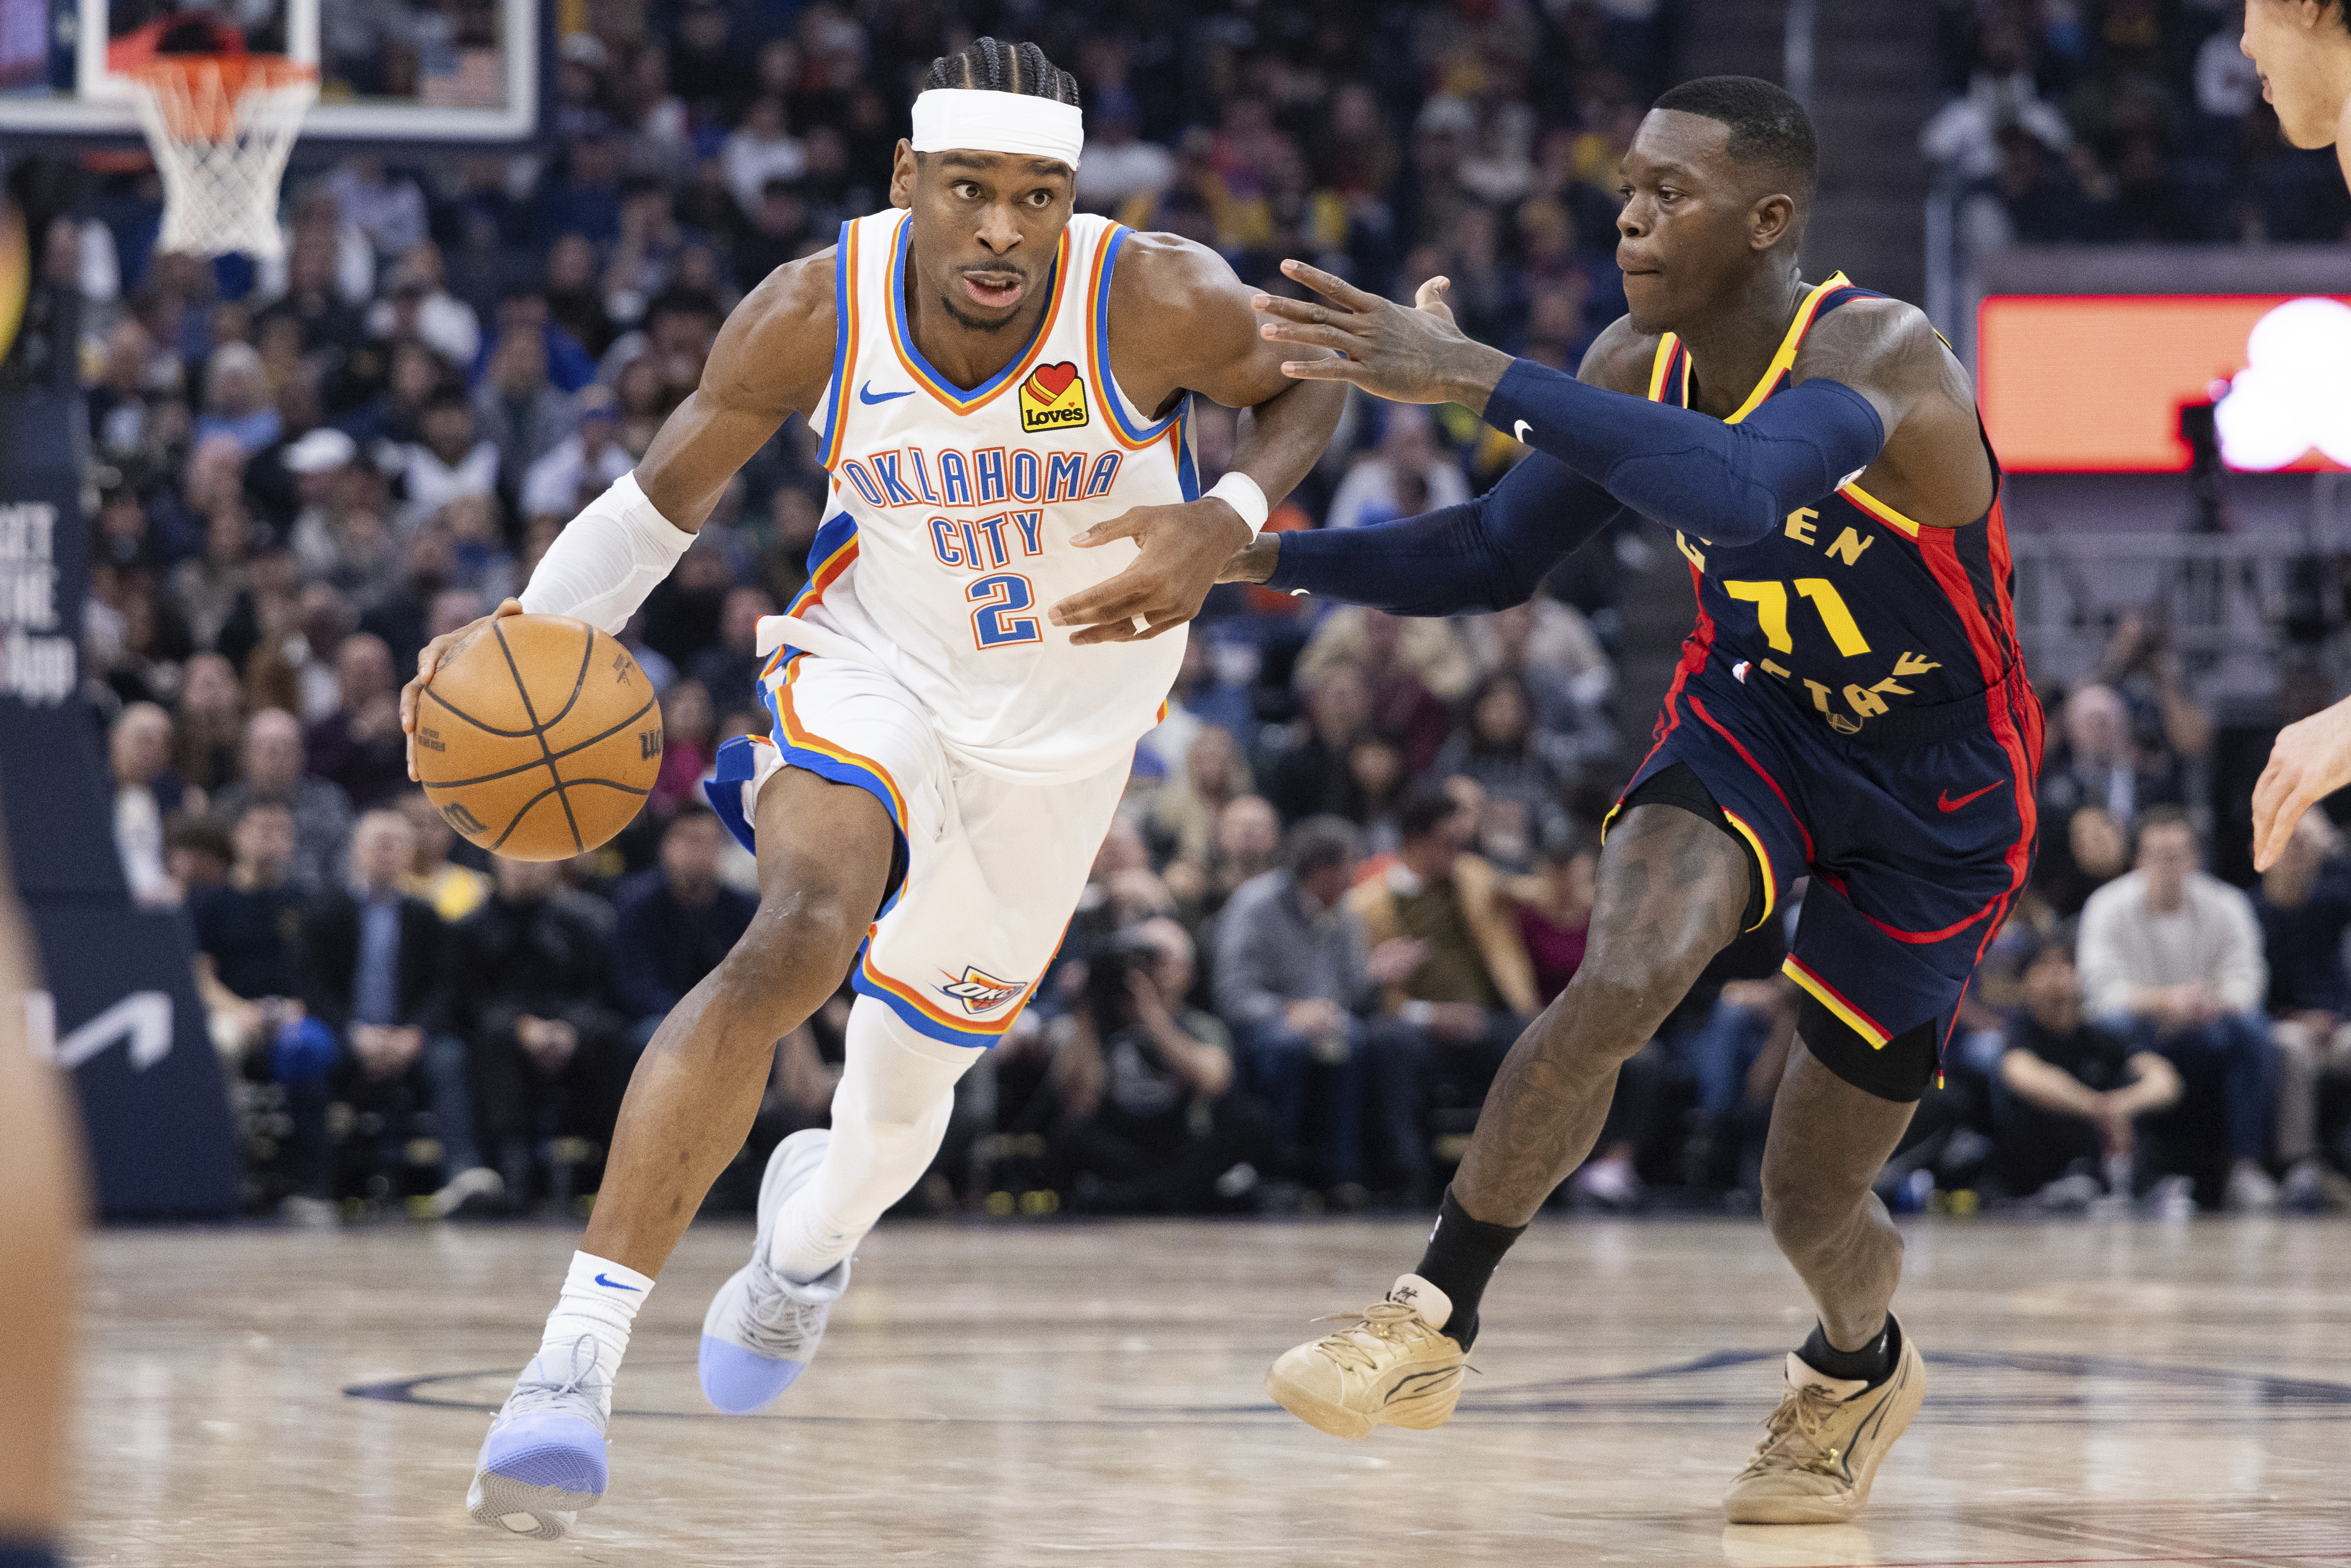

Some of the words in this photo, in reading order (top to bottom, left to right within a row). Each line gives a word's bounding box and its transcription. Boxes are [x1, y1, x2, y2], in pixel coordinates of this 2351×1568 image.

[842, 447, 1124, 508] OKLAHOMA
[928, 509, 1043, 571] CITY
[965, 572, 1043, 650] 2
[1723, 578, 1872, 657] 71
